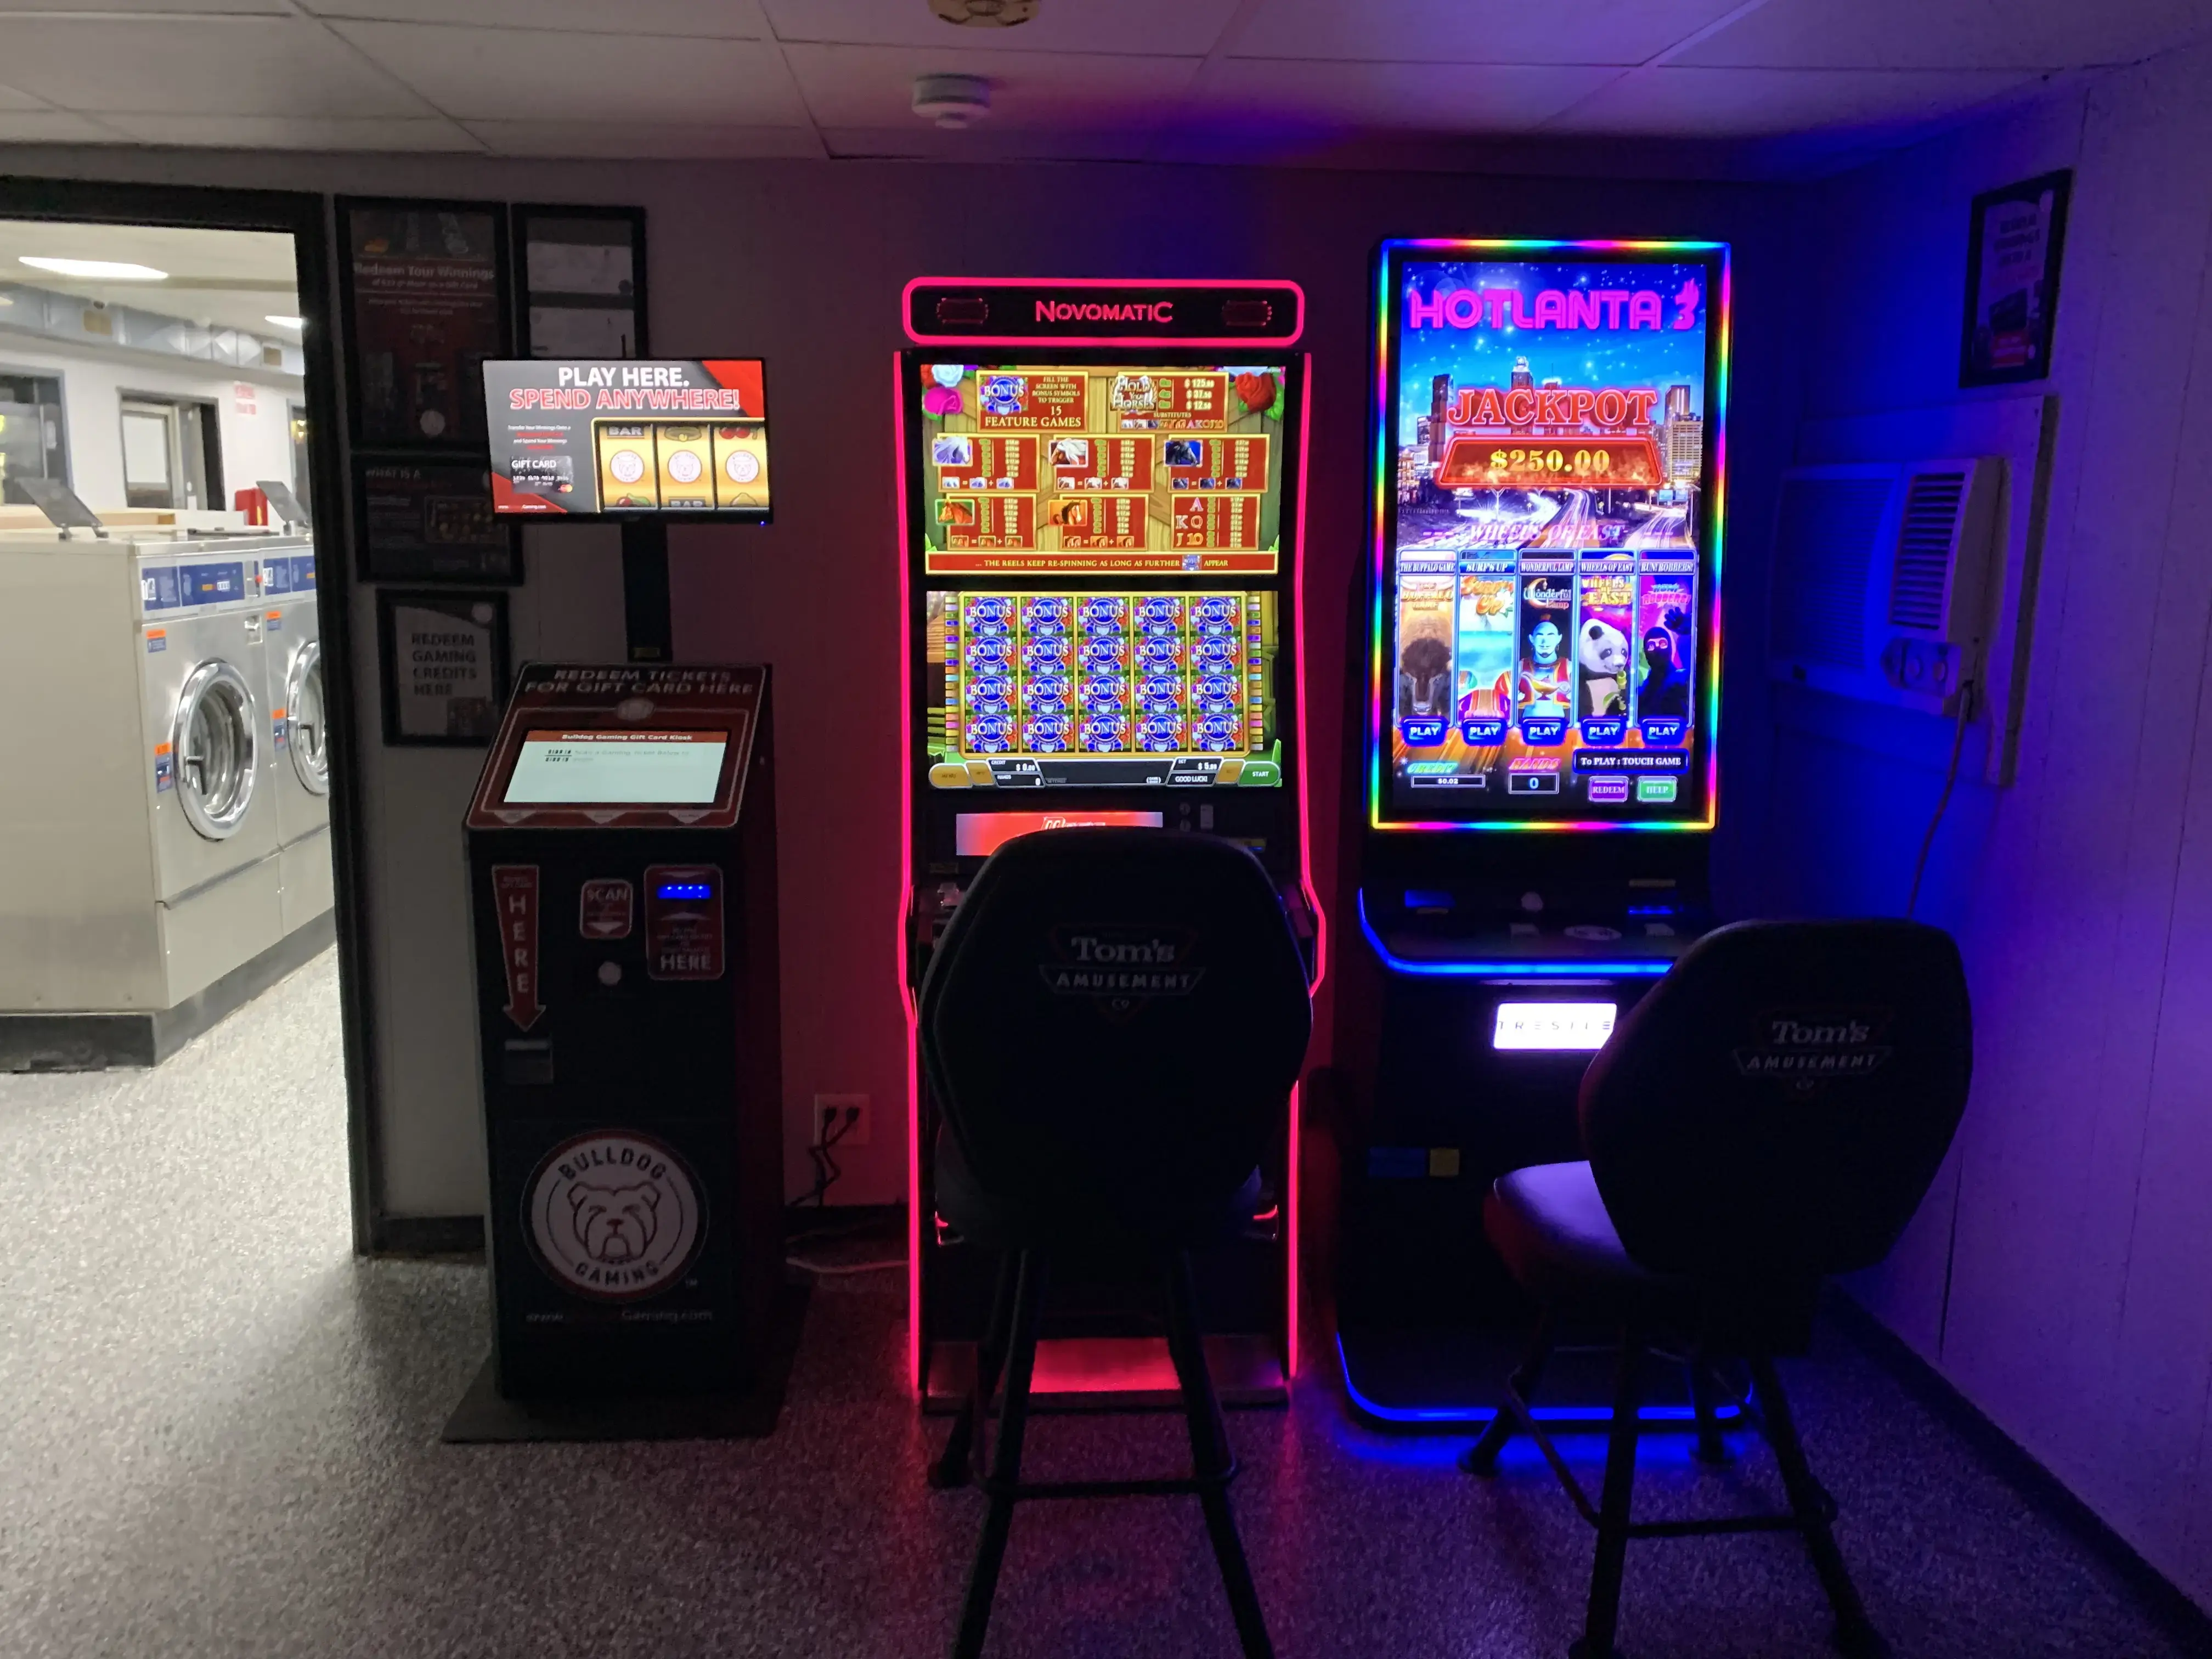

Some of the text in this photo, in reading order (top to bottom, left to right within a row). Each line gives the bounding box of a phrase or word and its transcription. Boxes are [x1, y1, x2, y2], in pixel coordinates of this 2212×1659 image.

[407, 266, 435, 277] Your
[437, 266, 495, 282] Winnings
[1035, 301, 1173, 323] NOVOMATIC
[1410, 289, 1662, 329] HOTLANTA
[558, 367, 690, 387] PLAY HERE.
[1114, 375, 1150, 392] HOLD
[984, 384, 1024, 397] BONUS
[509, 388, 741, 410] SPEND ANYWHERE!
[1051, 405, 1062, 416] 15
[984, 416, 1082, 427] FEATURE GAMES
[608, 427, 643, 436] BAR
[511, 460, 557, 469] GIFT CARD
[1189, 496, 1204, 511] A
[1175, 515, 1204, 529] K Q
[1176, 532, 1204, 546] J 10
[1400, 562, 1455, 572] THE BUFFALO GAME
[1466, 562, 1508, 572] SURF'S UP
[1558, 562, 1574, 572] LAMP
[1581, 562, 1633, 572] WHEELS OF EAST
[1588, 591, 1630, 604] EAST
[970, 605, 1236, 617] BONUS BONUS BONUS BONUS BONUS
[411, 633, 474, 646] REDEEM
[413, 650, 476, 663] GAMING
[970, 645, 1237, 657] BONUS BONUS BONUS BONUS BONUS
[413, 667, 477, 680] CREDITS
[554, 670, 731, 681] REDEEM TICKETS
[414, 683, 453, 696] HERE
[525, 682, 754, 695] FOR GIFT CARD HERE
[970, 683, 1237, 696] BONUS BONUS BONUS BONUS BONUS
[971, 722, 1238, 735] BONUS BONUS BONUS BONUS BONUS
[1410, 727, 1440, 735] PLAY
[1470, 727, 1499, 735] PLAY
[1530, 727, 1559, 735] PLAY
[1589, 727, 1618, 736] PLAY
[1649, 727, 1678, 736] PLAY
[1594, 757, 1616, 765] PLAY
[1622, 757, 1654, 766] TOUCH
[1656, 757, 1681, 765] GAME
[1530, 777, 1539, 789] 0
[586, 888, 627, 901] SCAN
[508, 894, 530, 994] HERE
[1071, 935, 1175, 963] Tom's
[660, 955, 711, 971] HERE
[1056, 972, 1190, 989] AMUSEMENT
[1772, 1019, 1870, 1044] Tom's
[1746, 1054, 1877, 1069] AMUSEMENT
[557, 1147, 667, 1180] BULLDOG
[575, 1260, 659, 1285] GAMING
